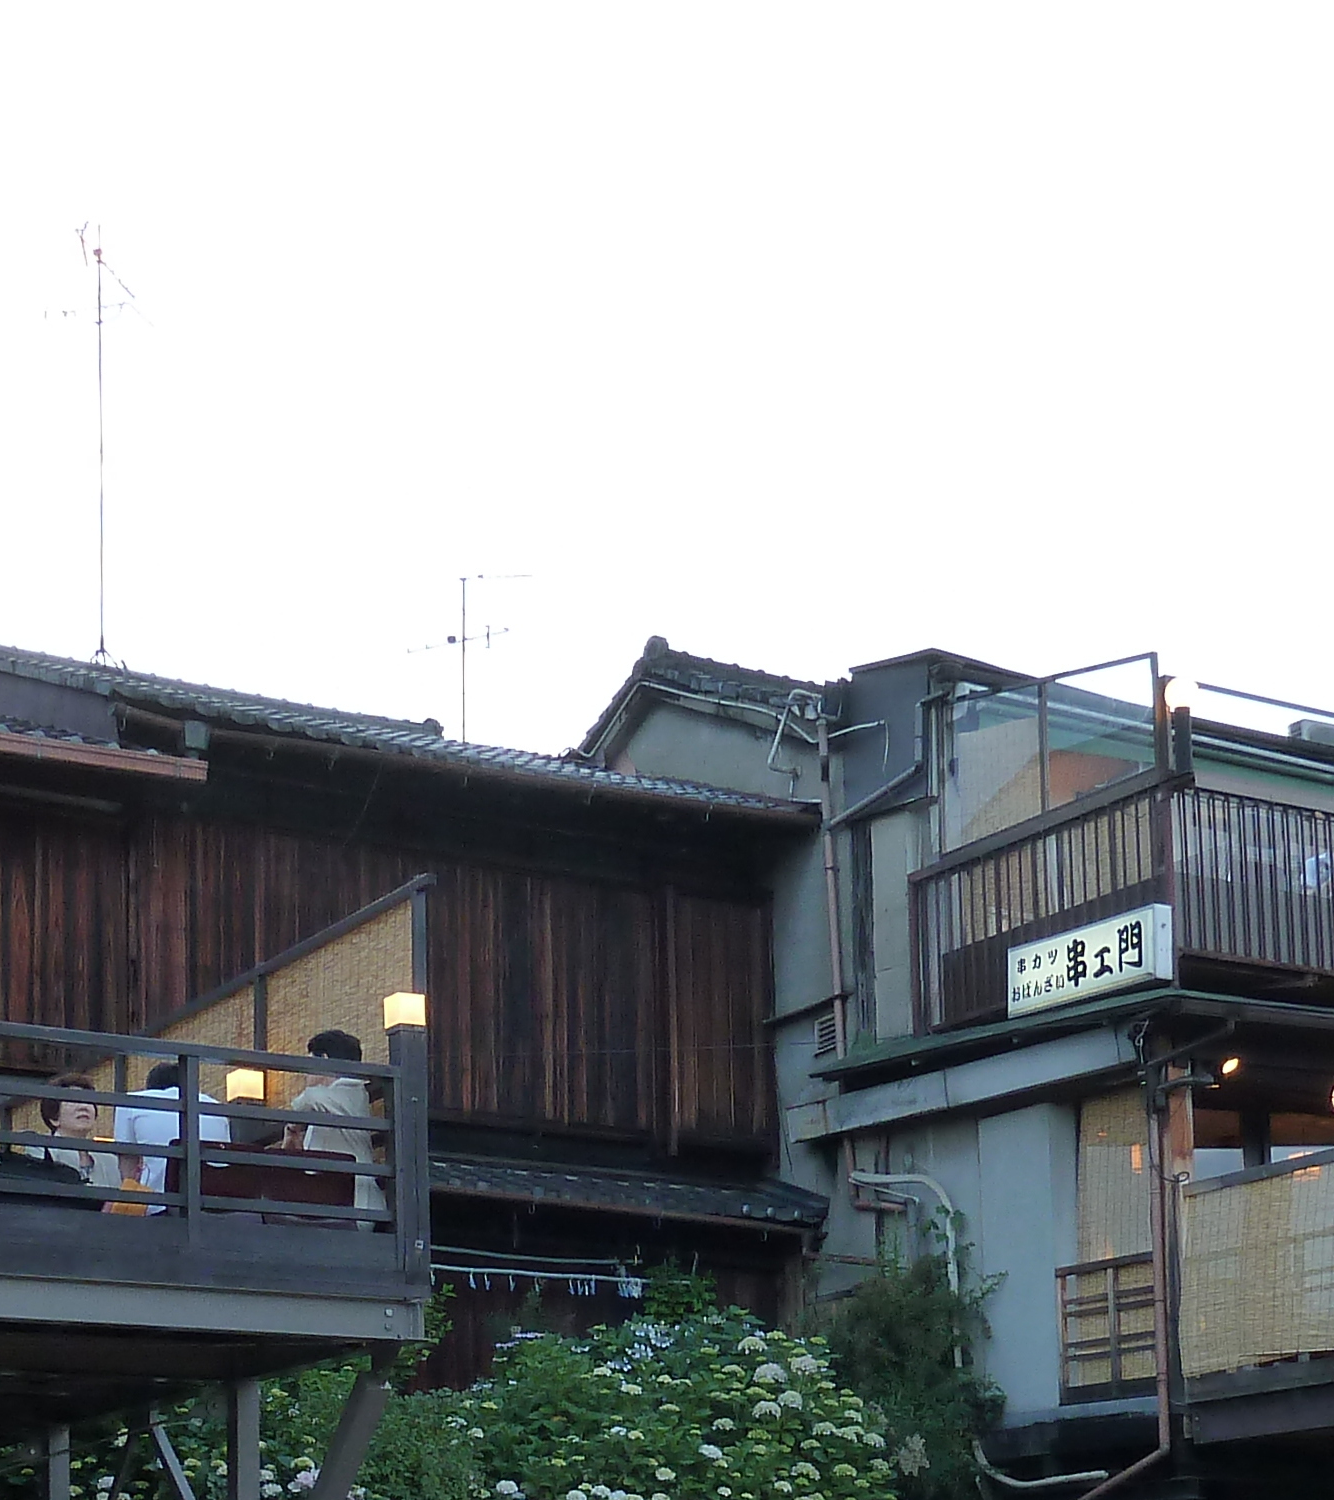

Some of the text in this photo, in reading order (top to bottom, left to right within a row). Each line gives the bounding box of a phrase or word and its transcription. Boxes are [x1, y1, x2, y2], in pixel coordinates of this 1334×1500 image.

[1017, 948, 1058, 975] 串カツ
[1012, 974, 1065, 1003] おばんざい
